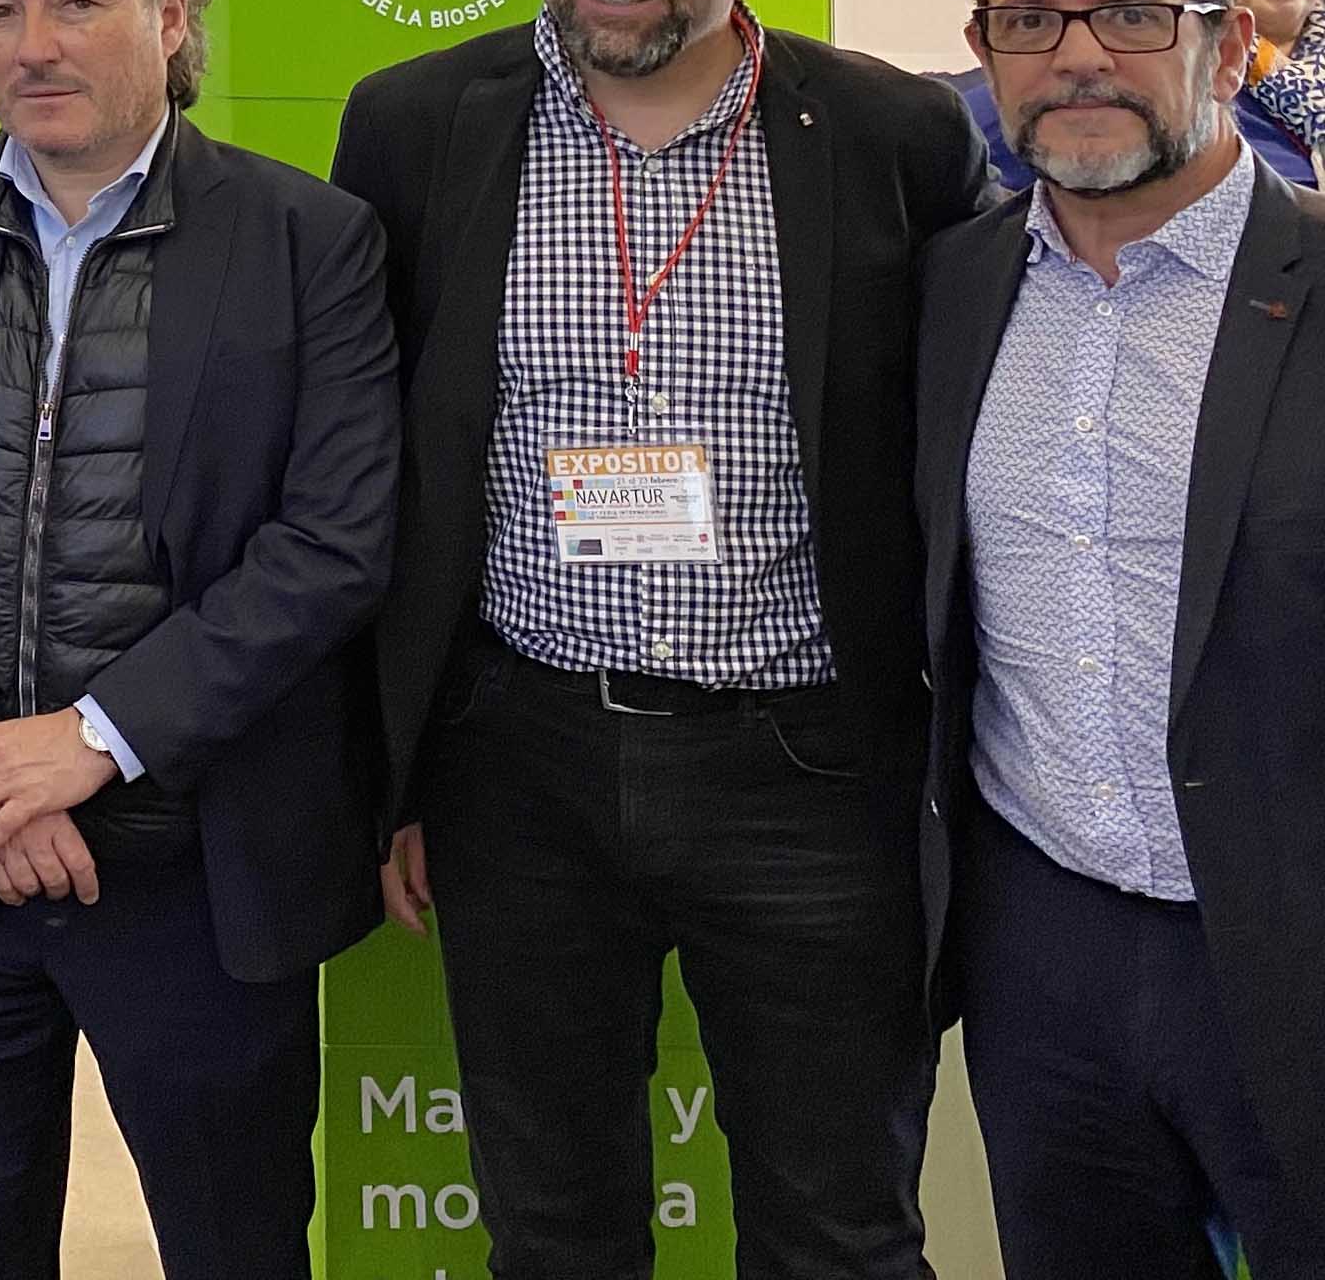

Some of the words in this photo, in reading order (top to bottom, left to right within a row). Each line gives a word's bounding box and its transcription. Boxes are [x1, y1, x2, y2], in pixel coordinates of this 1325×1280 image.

[394, 7, 423, 28] LA
[554, 451, 698, 475] EXPOSITOR
[575, 488, 665, 505] NAVARTUR
[359, 1075, 466, 1133] Ma
